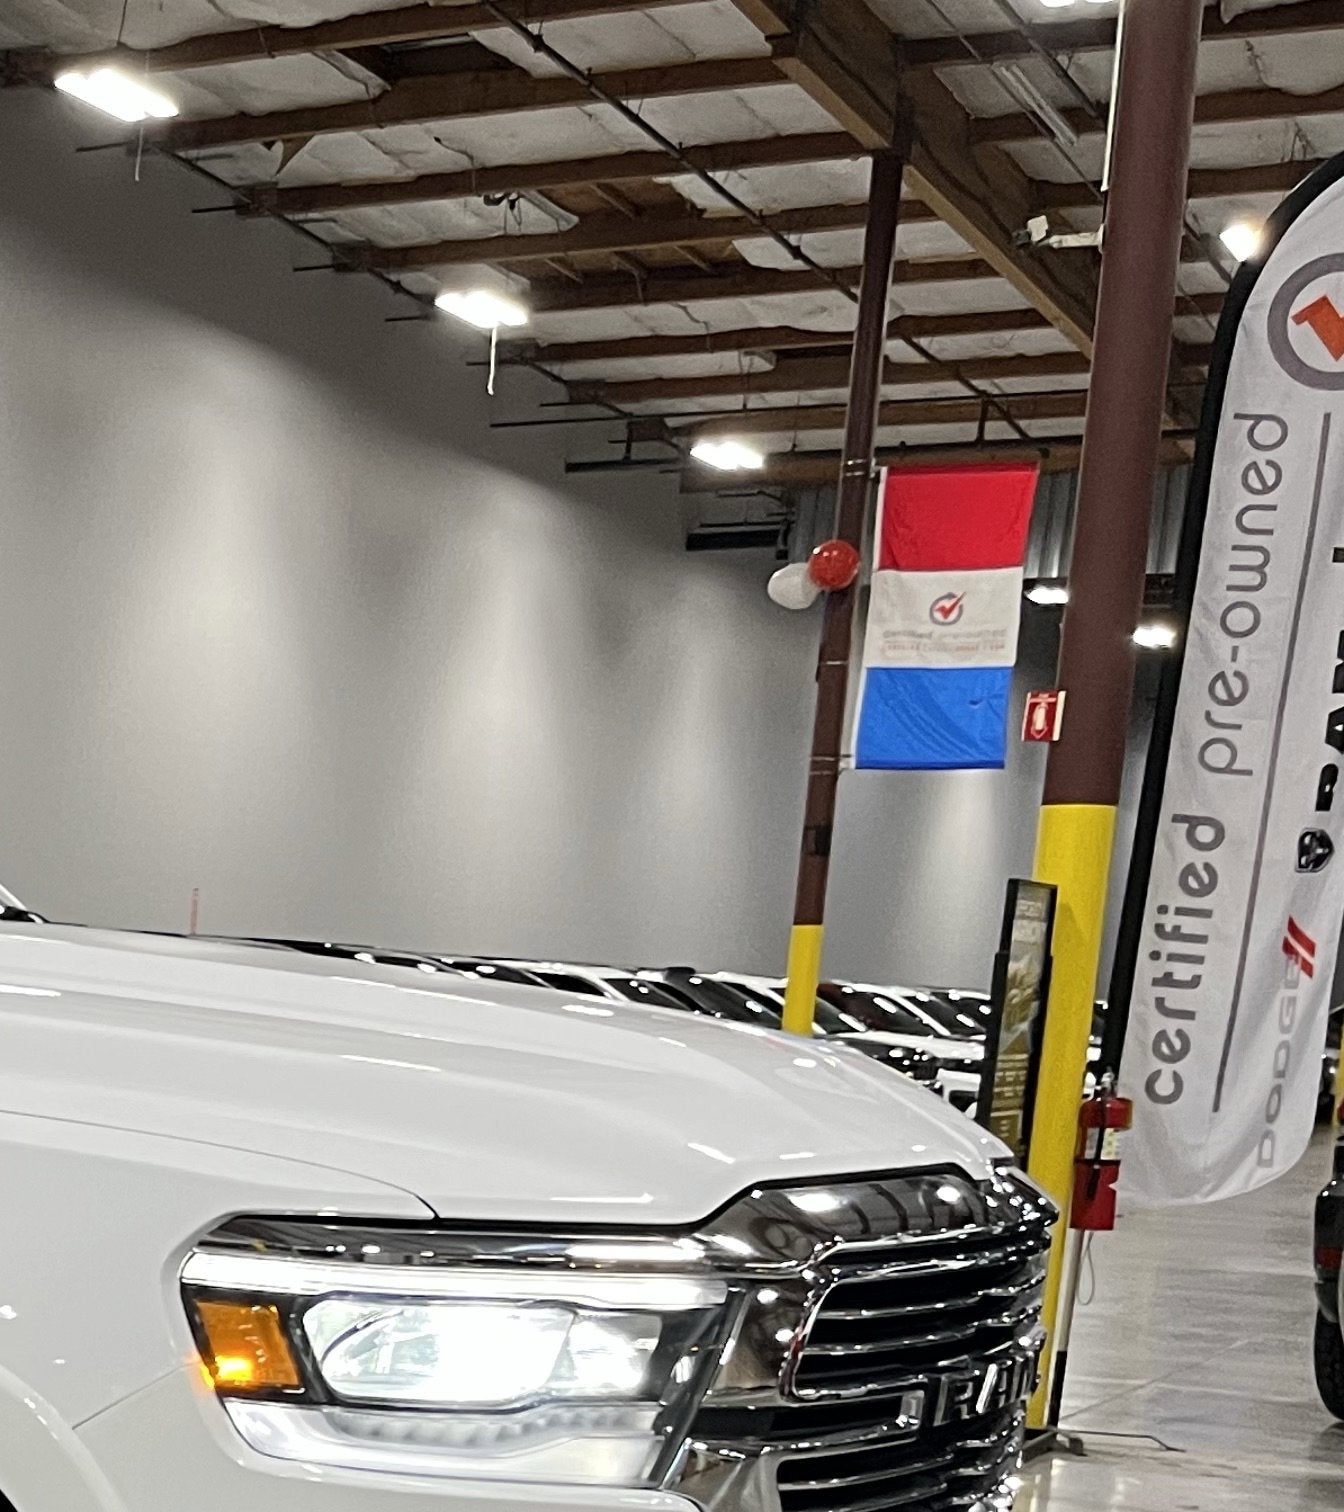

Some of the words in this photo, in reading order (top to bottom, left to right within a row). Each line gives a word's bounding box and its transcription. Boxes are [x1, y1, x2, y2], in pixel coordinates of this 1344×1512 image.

[1144, 813, 1226, 1105] certified
[1197, 413, 1289, 777] pre-owned
[1257, 954, 1302, 1168] DODGE
